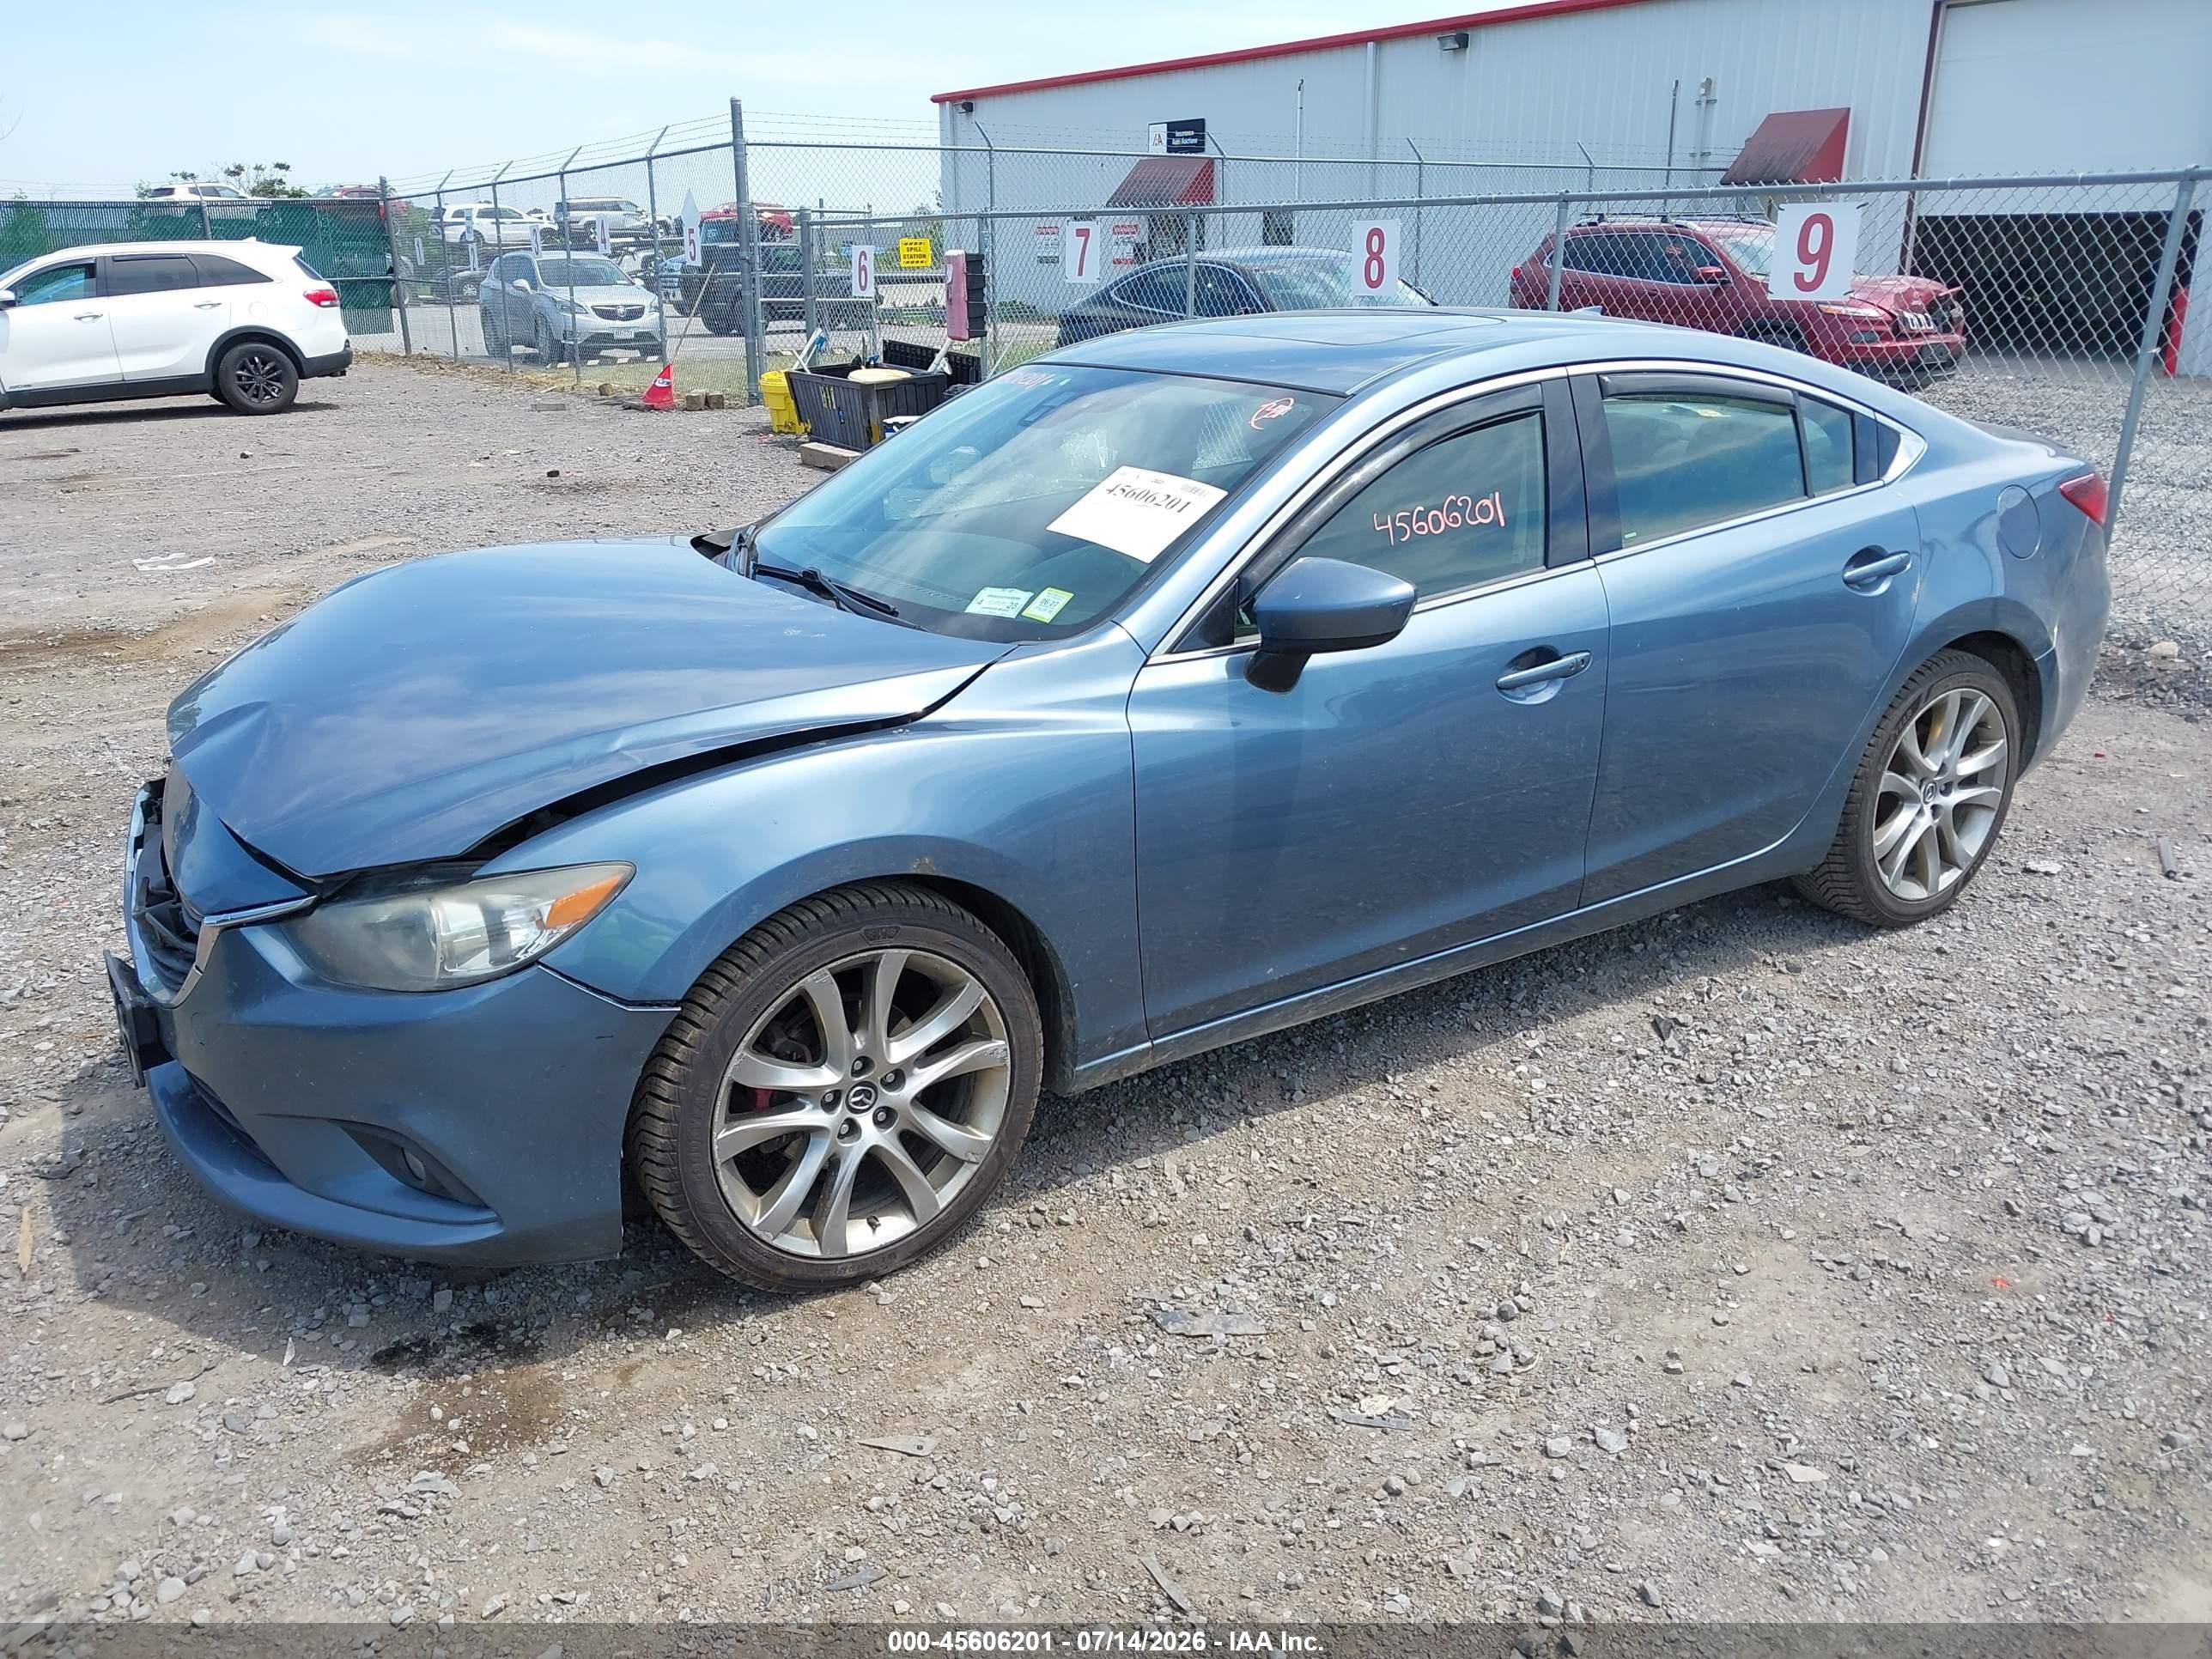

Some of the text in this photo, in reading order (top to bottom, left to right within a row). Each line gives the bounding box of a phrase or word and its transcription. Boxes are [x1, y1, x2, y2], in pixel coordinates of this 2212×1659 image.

[600, 219, 607, 250] 4
[688, 228, 696, 262] 5
[1075, 228, 1091, 276] 7
[1792, 212, 1835, 293] 9
[858, 250, 868, 292] 6
[1363, 227, 1386, 289] 8
[1105, 483, 1192, 514] 45606201
[1373, 491, 1505, 546] 45606201
